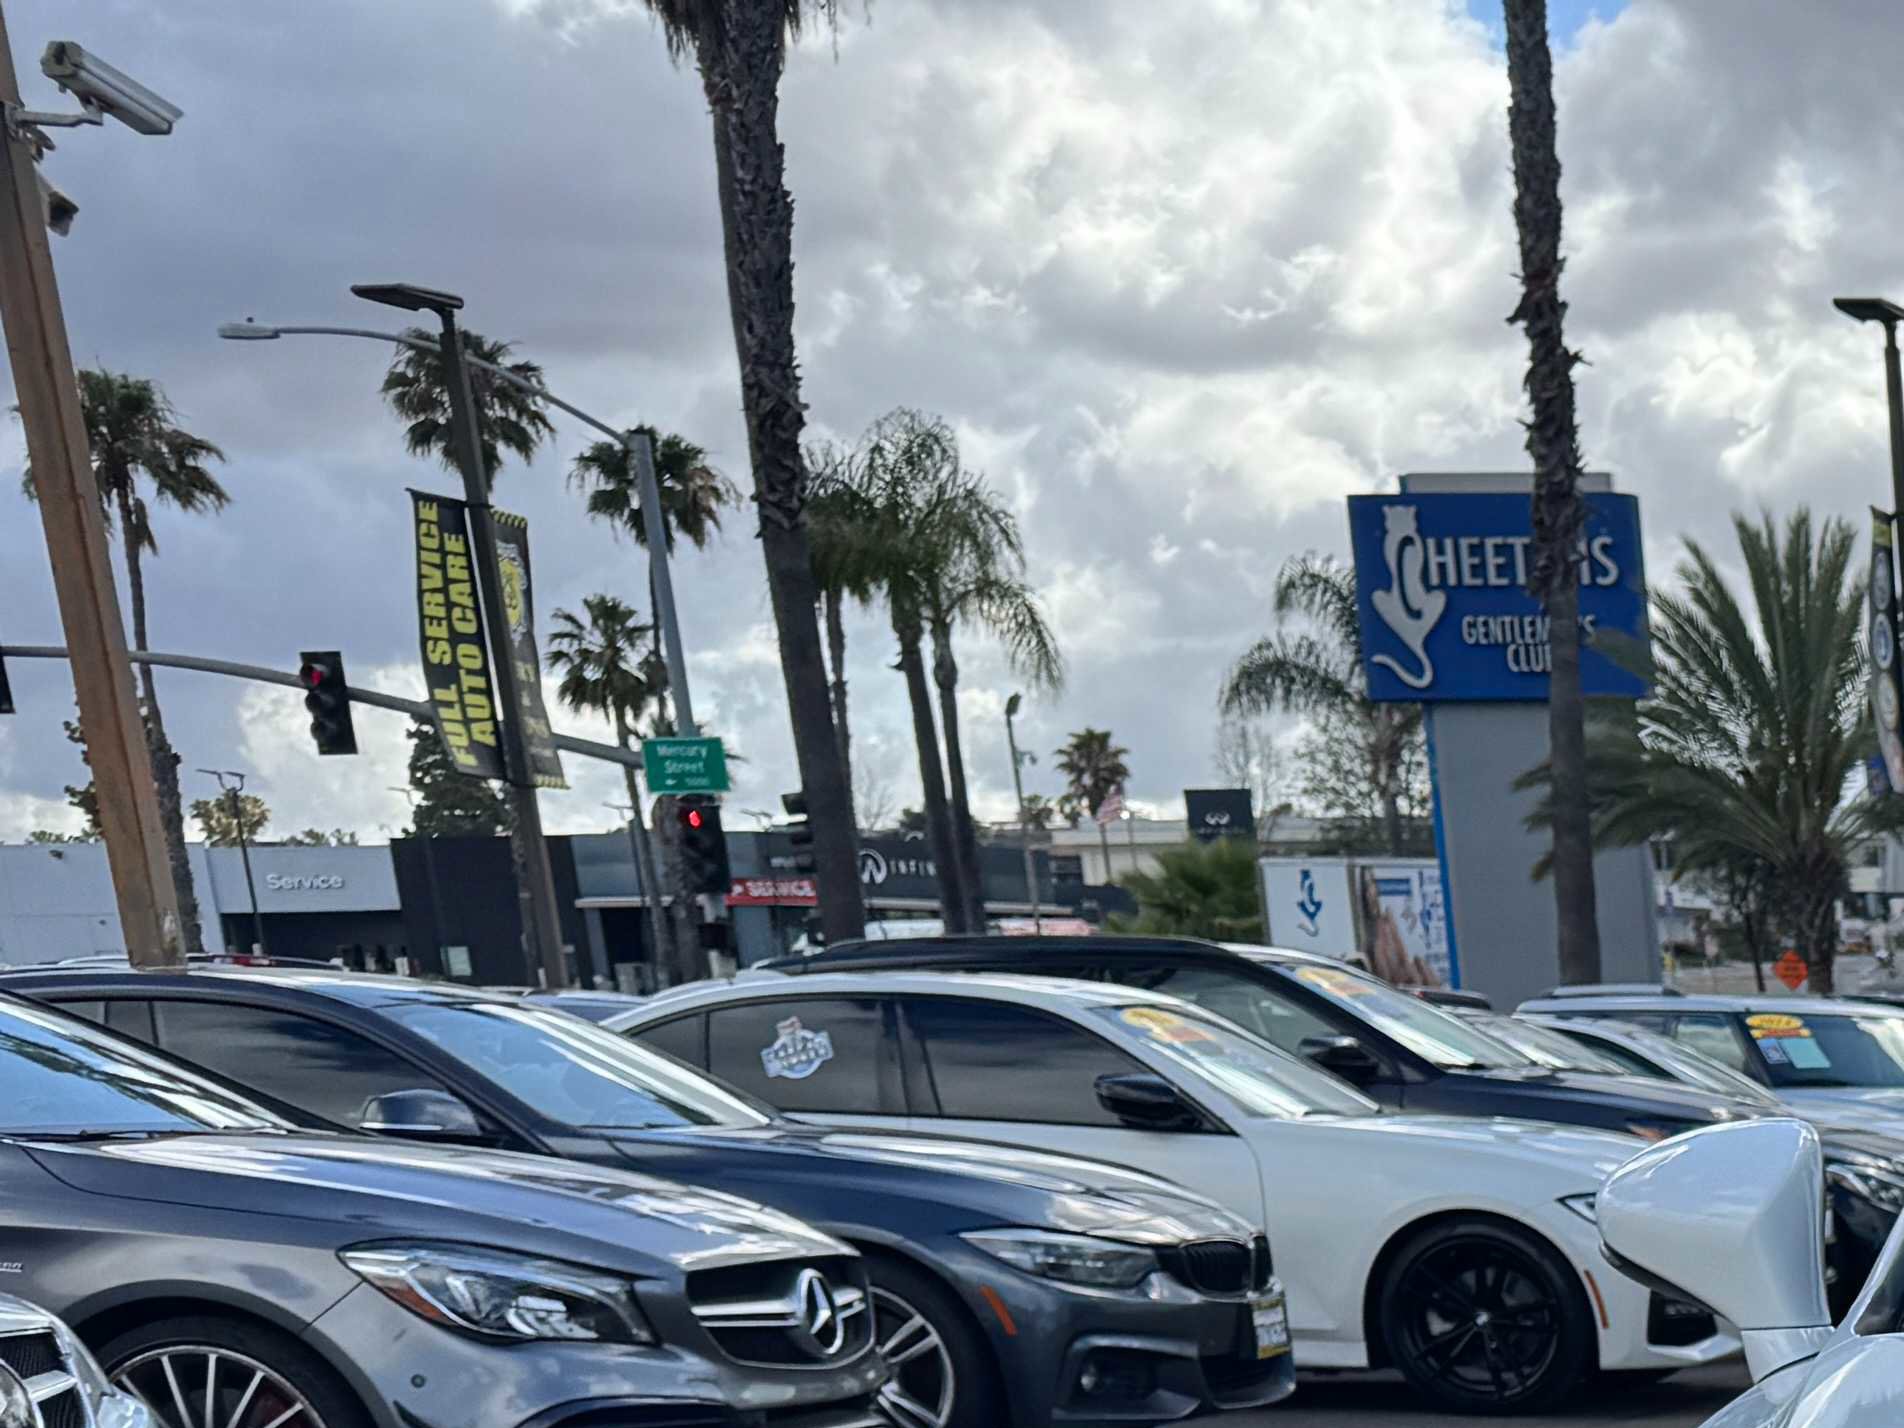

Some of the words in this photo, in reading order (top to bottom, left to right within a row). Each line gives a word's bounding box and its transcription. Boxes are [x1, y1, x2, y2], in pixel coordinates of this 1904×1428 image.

[418, 501, 452, 666] SERVICE
[443, 532, 479, 635] CARE
[434, 683, 478, 768] FULL
[456, 643, 497, 747] AUTO
[266, 873, 343, 889] Service
